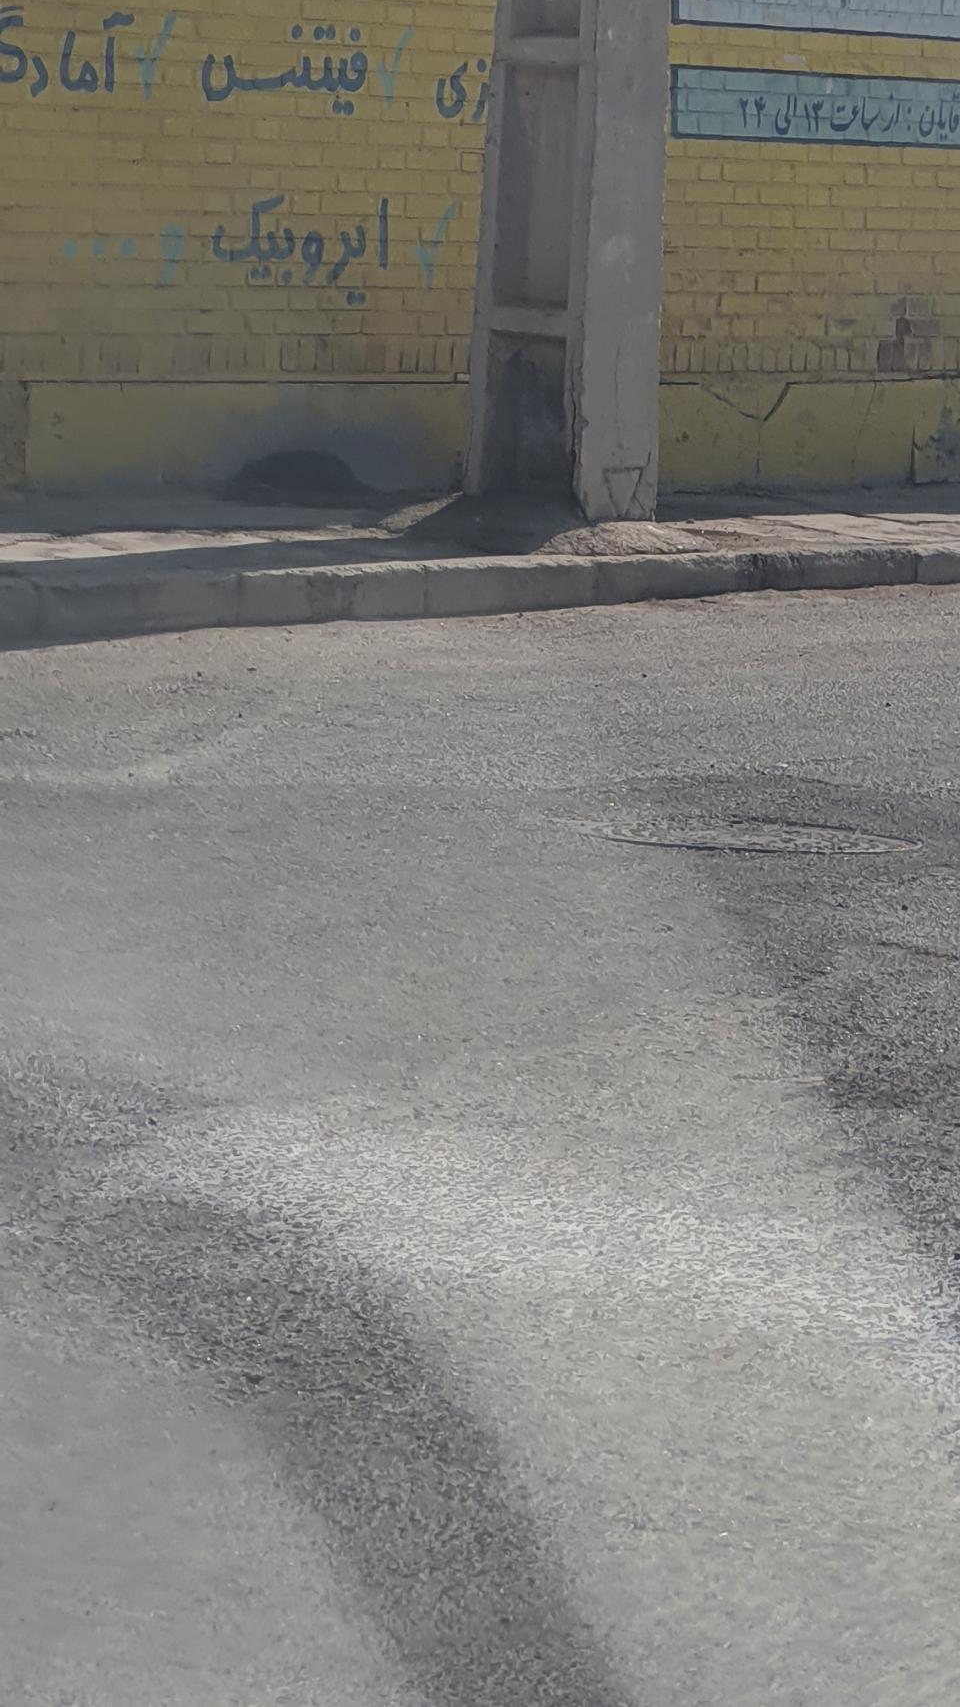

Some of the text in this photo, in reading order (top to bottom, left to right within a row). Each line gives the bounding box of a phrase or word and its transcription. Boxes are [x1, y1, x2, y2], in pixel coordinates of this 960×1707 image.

[201, 23, 369, 116] فیتنس
[739, 96, 767, 129] ۲۴
[774, 93, 798, 136] الی
[803, 99, 825, 134] ۱۳
[831, 97, 880, 133] ساعت
[879, 93, 901, 133] از
[210, 195, 389, 307] ایروبیک
